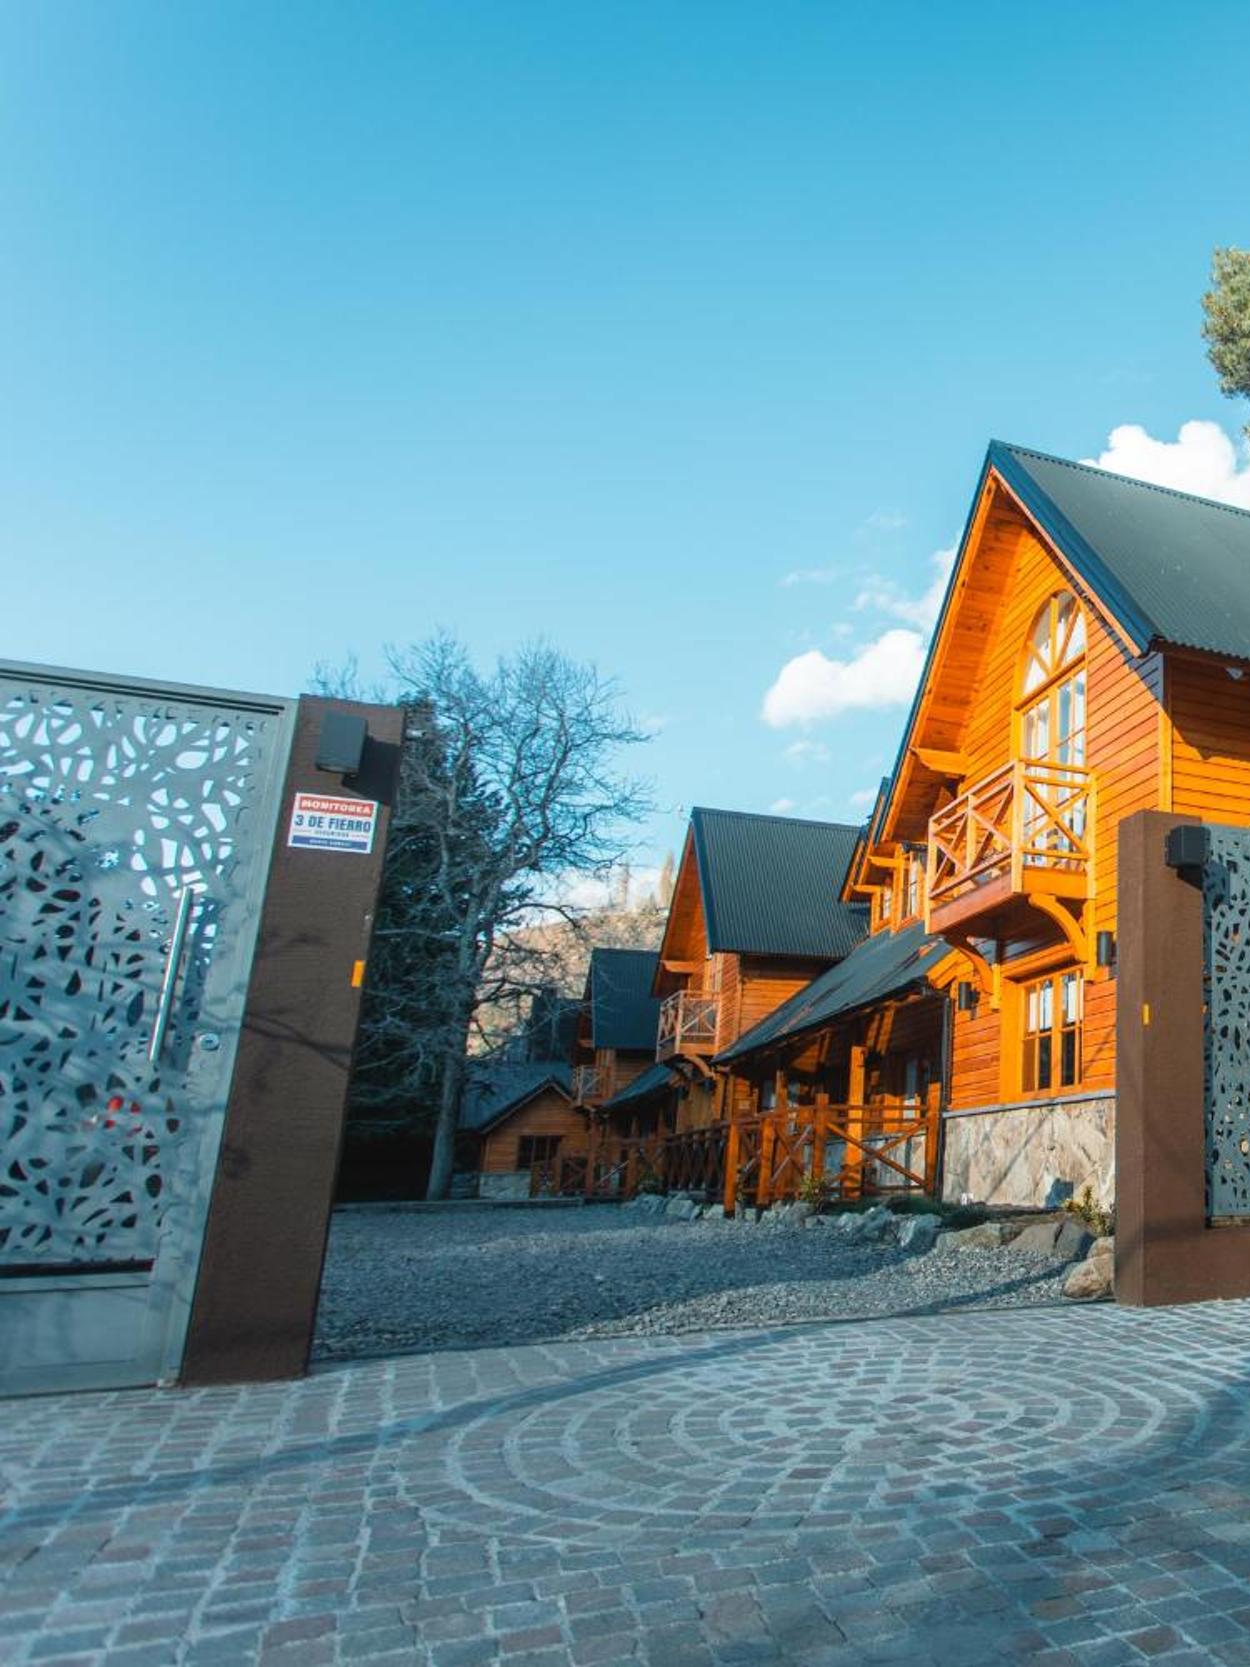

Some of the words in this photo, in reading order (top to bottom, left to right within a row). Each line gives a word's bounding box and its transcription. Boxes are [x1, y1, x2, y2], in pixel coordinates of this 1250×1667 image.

[295, 814, 304, 826] 3
[308, 816, 325, 828] DE
[328, 817, 370, 832] FIERRO
